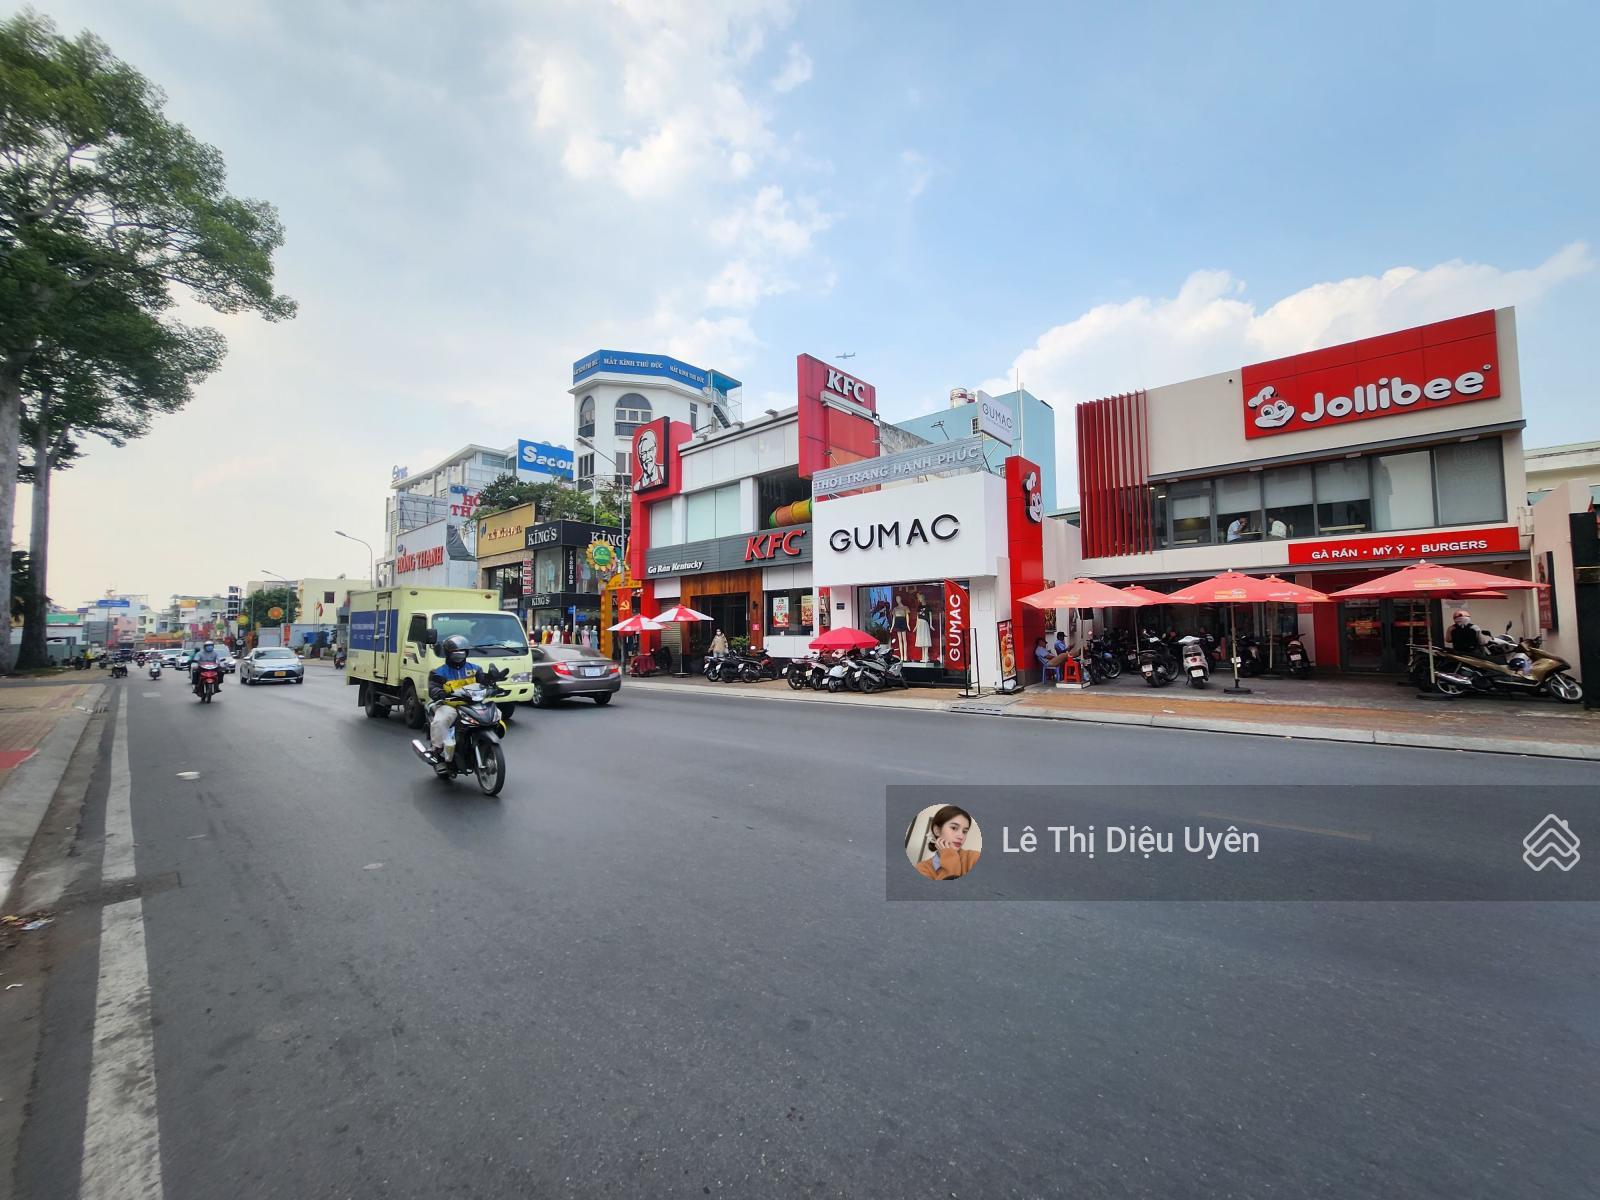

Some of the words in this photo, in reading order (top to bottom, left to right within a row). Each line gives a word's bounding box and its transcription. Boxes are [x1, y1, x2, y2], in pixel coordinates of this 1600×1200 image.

[827, 369, 865, 403] KFC
[1301, 371, 1485, 422] Jollibee
[983, 403, 1012, 429] GUMAC
[847, 466, 889, 484] TRANG
[938, 446, 979, 465] PHÚC
[745, 530, 803, 561] KFC
[829, 513, 960, 552] GUMAC
[1311, 548, 1329, 559] GÀ
[1331, 547, 1358, 558] RÁN
[1396, 543, 1405, 554] Ý
[1421, 540, 1488, 553] BURGERS
[672, 560, 703, 571] Kentucky
[949, 594, 962, 661] GUMAC
